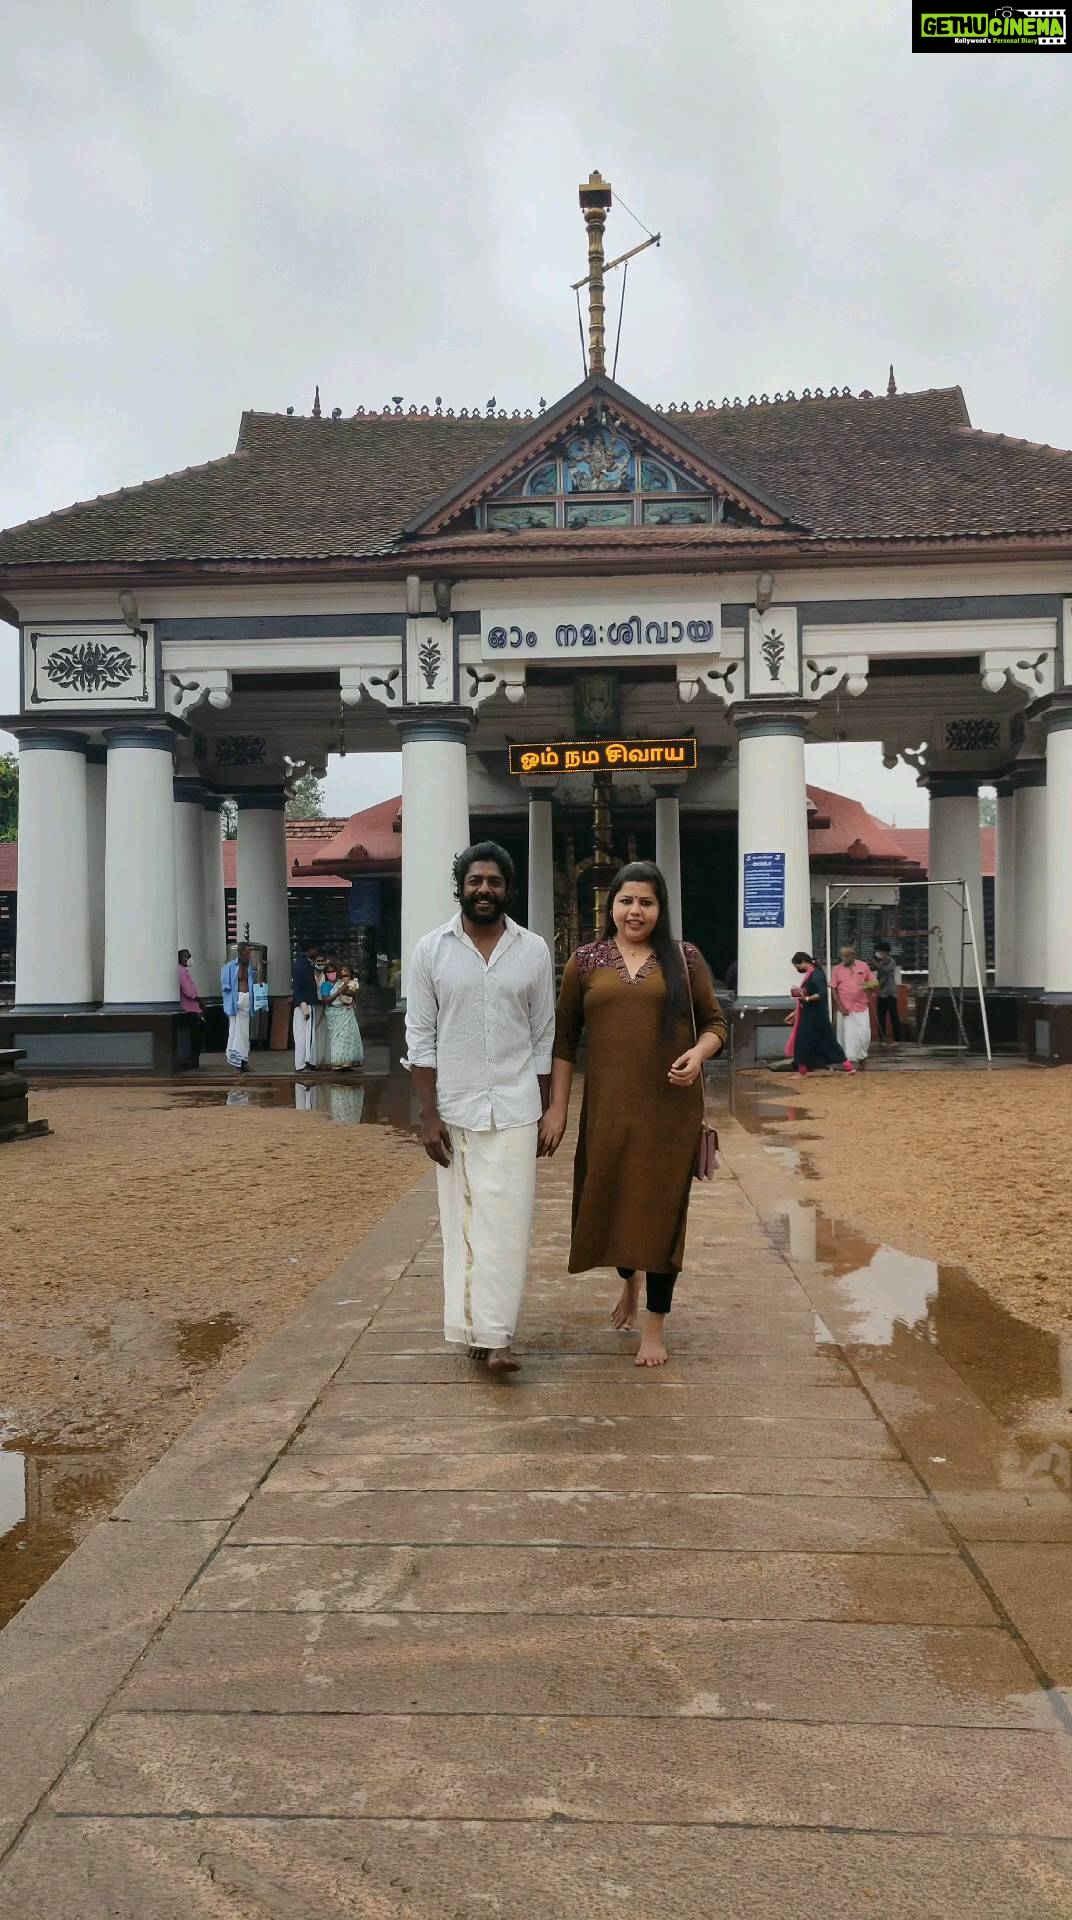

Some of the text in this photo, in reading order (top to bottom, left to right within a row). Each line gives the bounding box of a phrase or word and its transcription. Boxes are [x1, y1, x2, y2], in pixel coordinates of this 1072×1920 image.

[520, 743, 685, 770] ஓம் நம சிவாய
